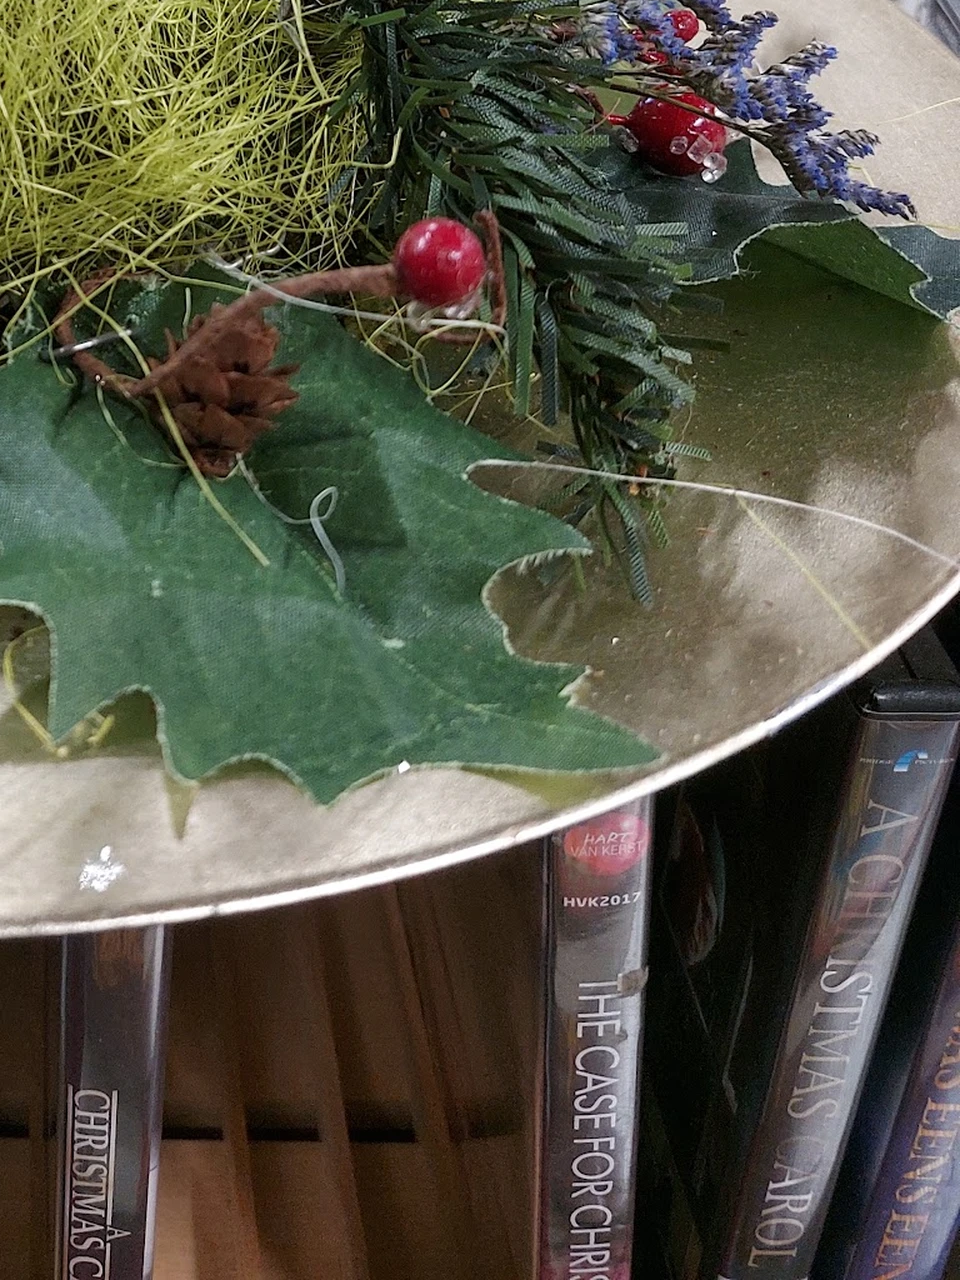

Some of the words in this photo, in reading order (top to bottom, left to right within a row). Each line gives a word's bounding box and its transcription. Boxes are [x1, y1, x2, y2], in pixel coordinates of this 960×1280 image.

[583, 832, 634, 847] HART
[861, 799, 919, 837] A
[570, 845, 598, 857] VAN
[563, 891, 641, 908] HVK2017
[576, 974, 622, 1039] THE
[787, 854, 905, 1119] CHRISTMAS
[573, 1045, 620, 1131] CASE
[69, 1089, 111, 1251] CHRISTMAS
[571, 1137, 615, 1198] FOR
[895, 1097, 960, 1204] EENS
[747, 1134, 828, 1269] CAROL
[107, 1225, 132, 1242] A
